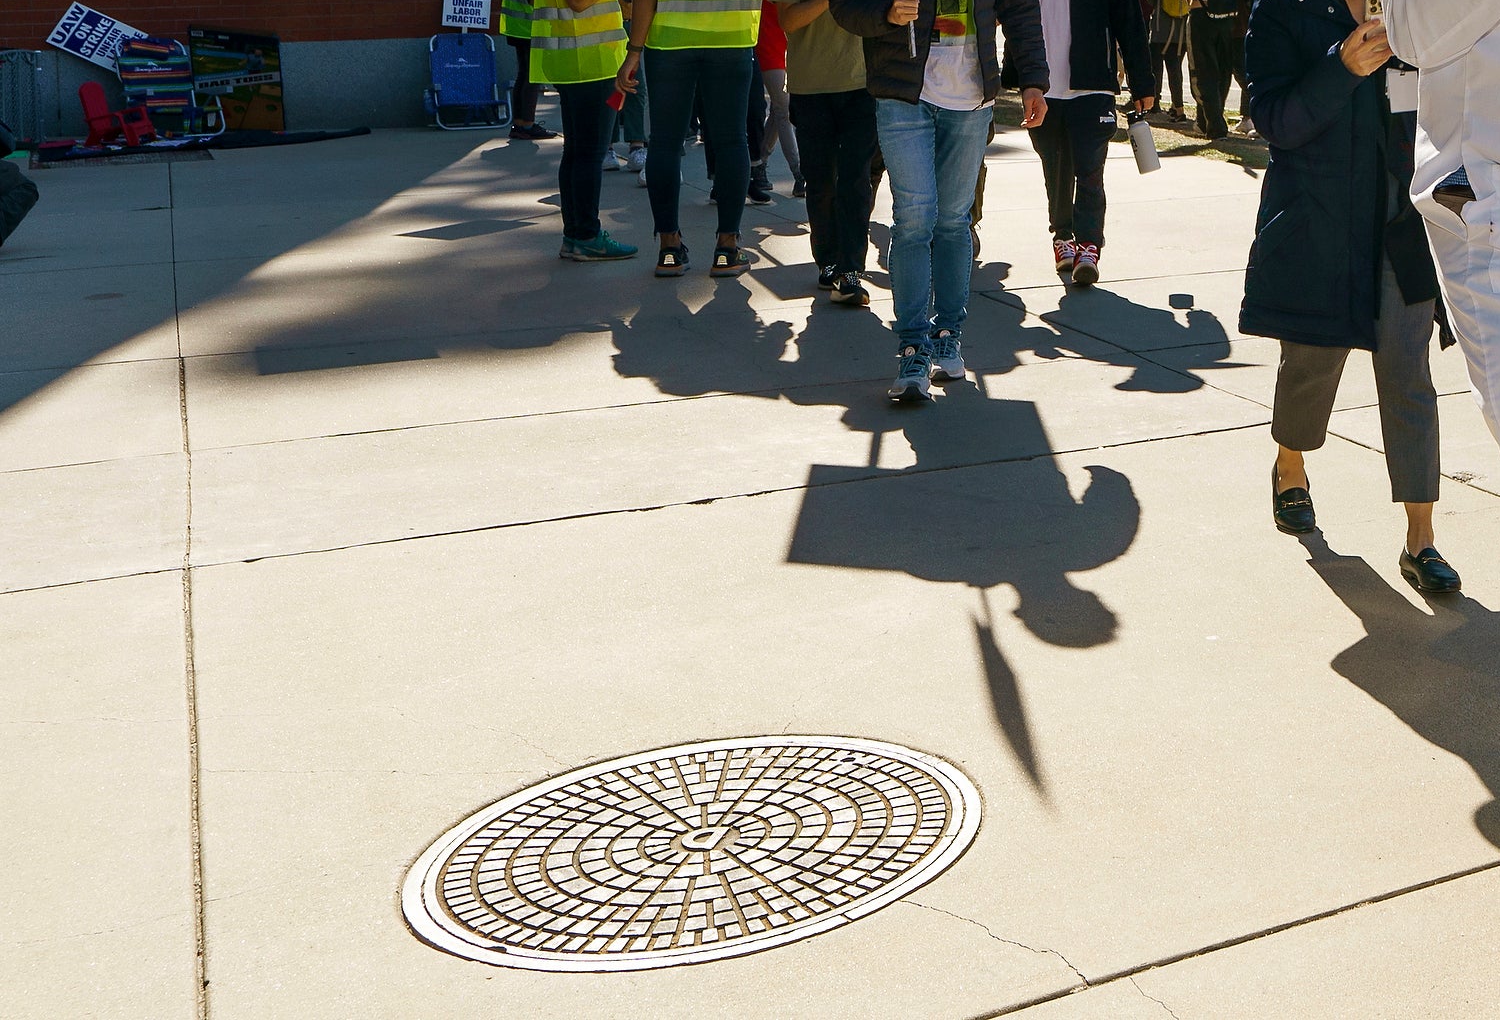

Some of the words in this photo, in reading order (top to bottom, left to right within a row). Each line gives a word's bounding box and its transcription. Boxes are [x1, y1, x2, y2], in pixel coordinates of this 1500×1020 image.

[446, 14, 487, 25] PRACTICE
[453, 7, 481, 16] LABOR
[50, 3, 86, 45] UAW
[75, 21, 93, 40] ON
[79, 17, 113, 56] STRIKE
[96, 28, 122, 58] UNFAIR
